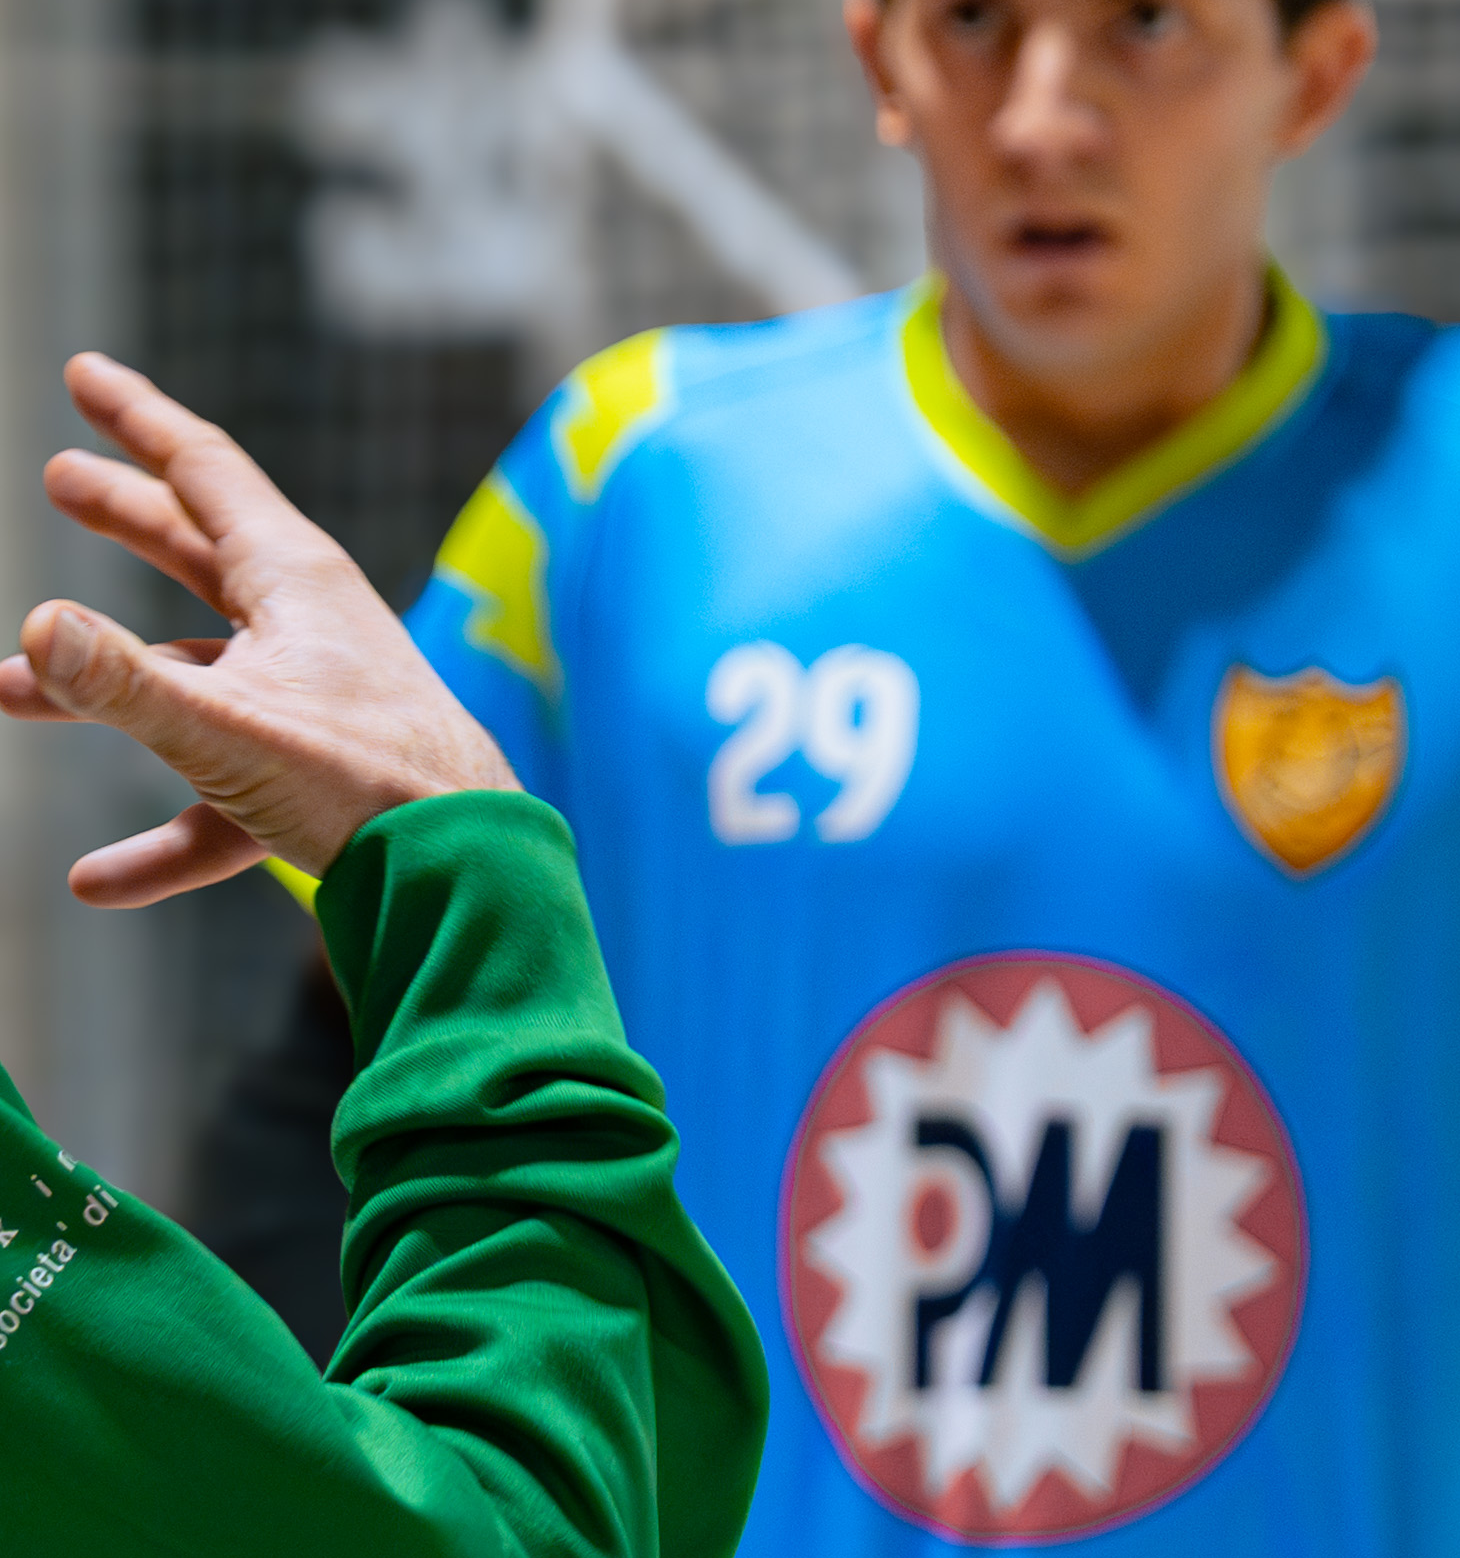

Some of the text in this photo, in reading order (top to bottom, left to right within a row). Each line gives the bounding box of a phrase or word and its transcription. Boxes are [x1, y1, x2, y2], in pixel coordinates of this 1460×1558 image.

[707, 641, 920, 844] 29
[83, 1184, 119, 1227] di
[909, 1108, 1174, 1394] PM
